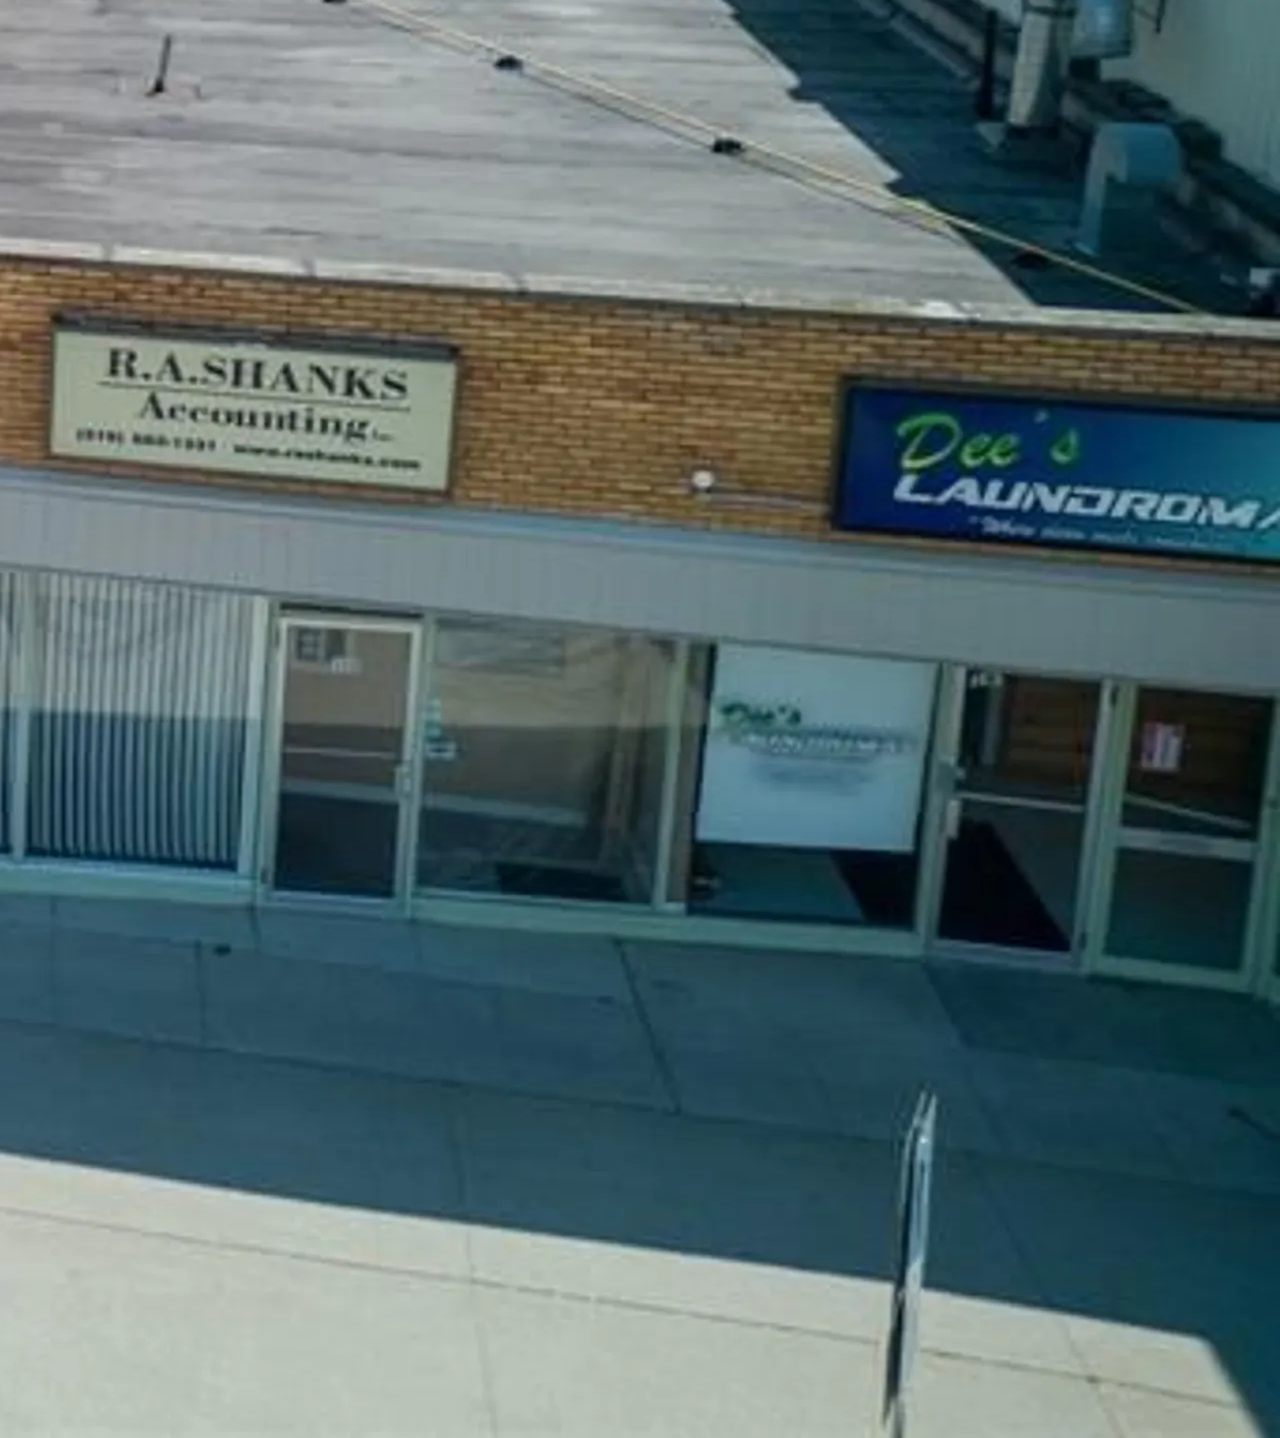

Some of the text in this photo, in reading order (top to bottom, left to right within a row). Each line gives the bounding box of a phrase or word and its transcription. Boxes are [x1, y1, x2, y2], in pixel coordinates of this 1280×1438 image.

[139, 390, 370, 444] Accounting
[895, 410, 1081, 472] Dee's
[892, 473, 1280, 530] LAUNDROM
